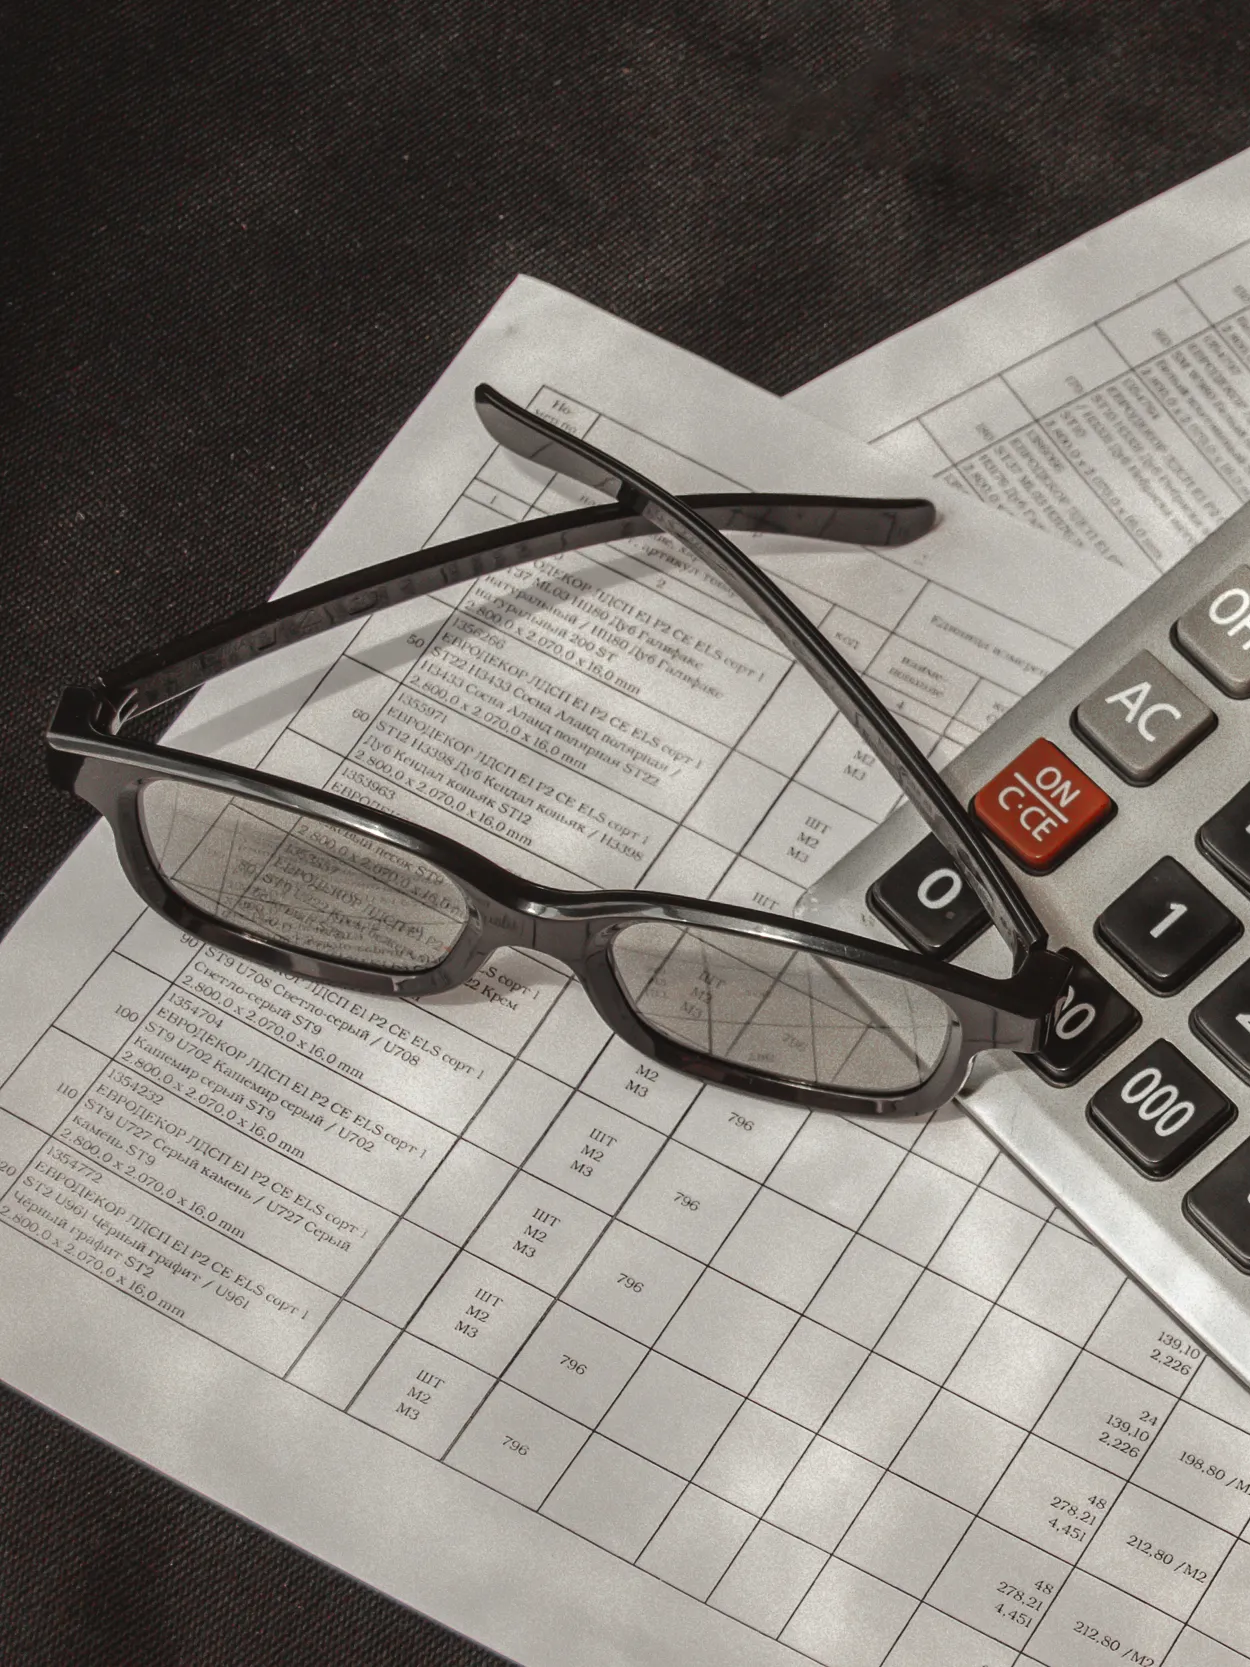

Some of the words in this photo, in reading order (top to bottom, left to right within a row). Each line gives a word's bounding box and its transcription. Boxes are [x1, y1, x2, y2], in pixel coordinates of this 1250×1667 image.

[405, 632, 426, 648] 50
[351, 707, 371, 723] 60
[1105, 681, 1180, 742] AC
[1035, 765, 1081, 808] ON
[917, 867, 962, 909] 0
[1149, 902, 1188, 938] 1
[114, 1003, 140, 1023] 100
[167, 992, 224, 1029] 1354704
[382, 1039, 421, 1067] U708
[55, 1081, 79, 1099] 110
[175, 1037, 213, 1065] U702
[211, 1058, 280, 1104] Кашемир
[279, 1098, 324, 1127] серый
[337, 1125, 375, 1153] U702
[1120, 1066, 1196, 1137] 000
[727, 1110, 755, 1132] 796
[588, 1127, 618, 1147] ШТ
[45, 1145, 103, 1184] 1354772
[114, 1115, 153, 1141] U727
[199, 1165, 252, 1200] камень
[265, 1199, 305, 1225] U727
[303, 1220, 351, 1253] Серый
[673, 1190, 701, 1212] 796
[531, 1207, 561, 1227] ШТ
[616, 1272, 645, 1294] 796
[474, 1287, 504, 1308] ШТ
[1155, 1329, 1203, 1361] 139,10
[559, 1353, 588, 1376] 796
[1149, 1348, 1192, 1376] 2,226
[415, 1368, 446, 1389] ШТ
[1105, 1413, 1150, 1442] 139,10
[1138, 1410, 1158, 1427] 24
[501, 1434, 530, 1456] 796
[1097, 1430, 1141, 1458] 2,226
[1178, 1450, 1226, 1481] 198,80
[1049, 1495, 1097, 1526] 278,21
[1087, 1494, 1108, 1510] 48
[1047, 1517, 1087, 1543] 4,451
[1125, 1534, 1174, 1565] 212,80
[995, 1580, 1044, 1612] 278,21
[1033, 1579, 1054, 1595] 48
[994, 1602, 1033, 1629] 4,451
[1072, 1620, 1121, 1652] 212,80
